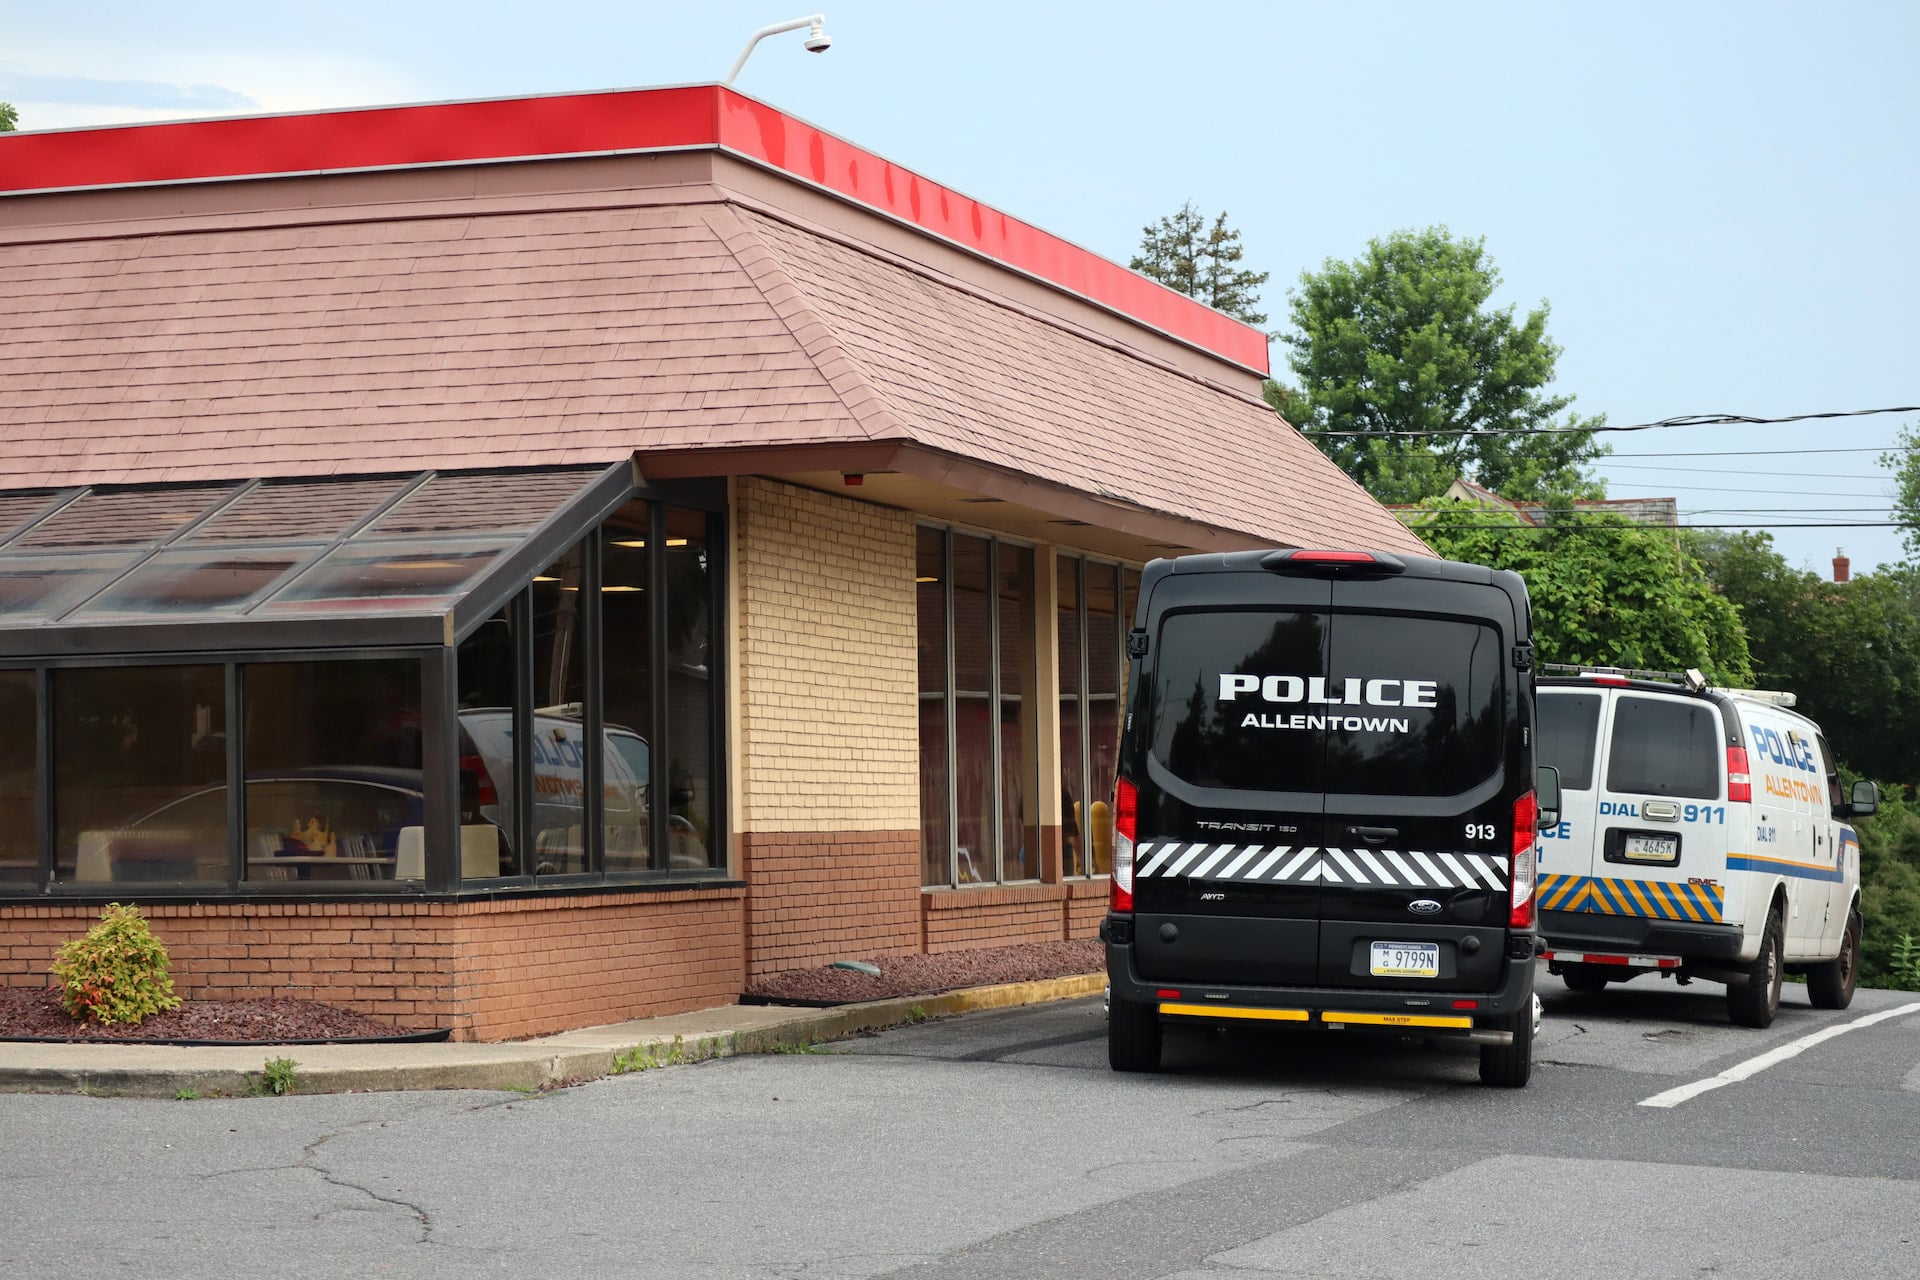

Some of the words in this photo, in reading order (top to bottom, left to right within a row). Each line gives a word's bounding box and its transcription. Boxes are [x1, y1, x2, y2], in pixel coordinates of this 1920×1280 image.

[1219, 673, 1438, 708] POLICE
[1241, 713, 1409, 733] ALLENTOWN
[1750, 725, 1816, 773] POLICE
[1765, 774, 1823, 805] ALLENTOWN
[1600, 802, 1639, 818] DIAL
[1683, 805, 1725, 825] 911
[1197, 821, 1275, 831] TRANSIT
[1465, 823, 1496, 840] 913
[1643, 840, 1673, 854] 4645K
[1688, 877, 1717, 886] GMC
[1395, 951, 1434, 968] 9799N
